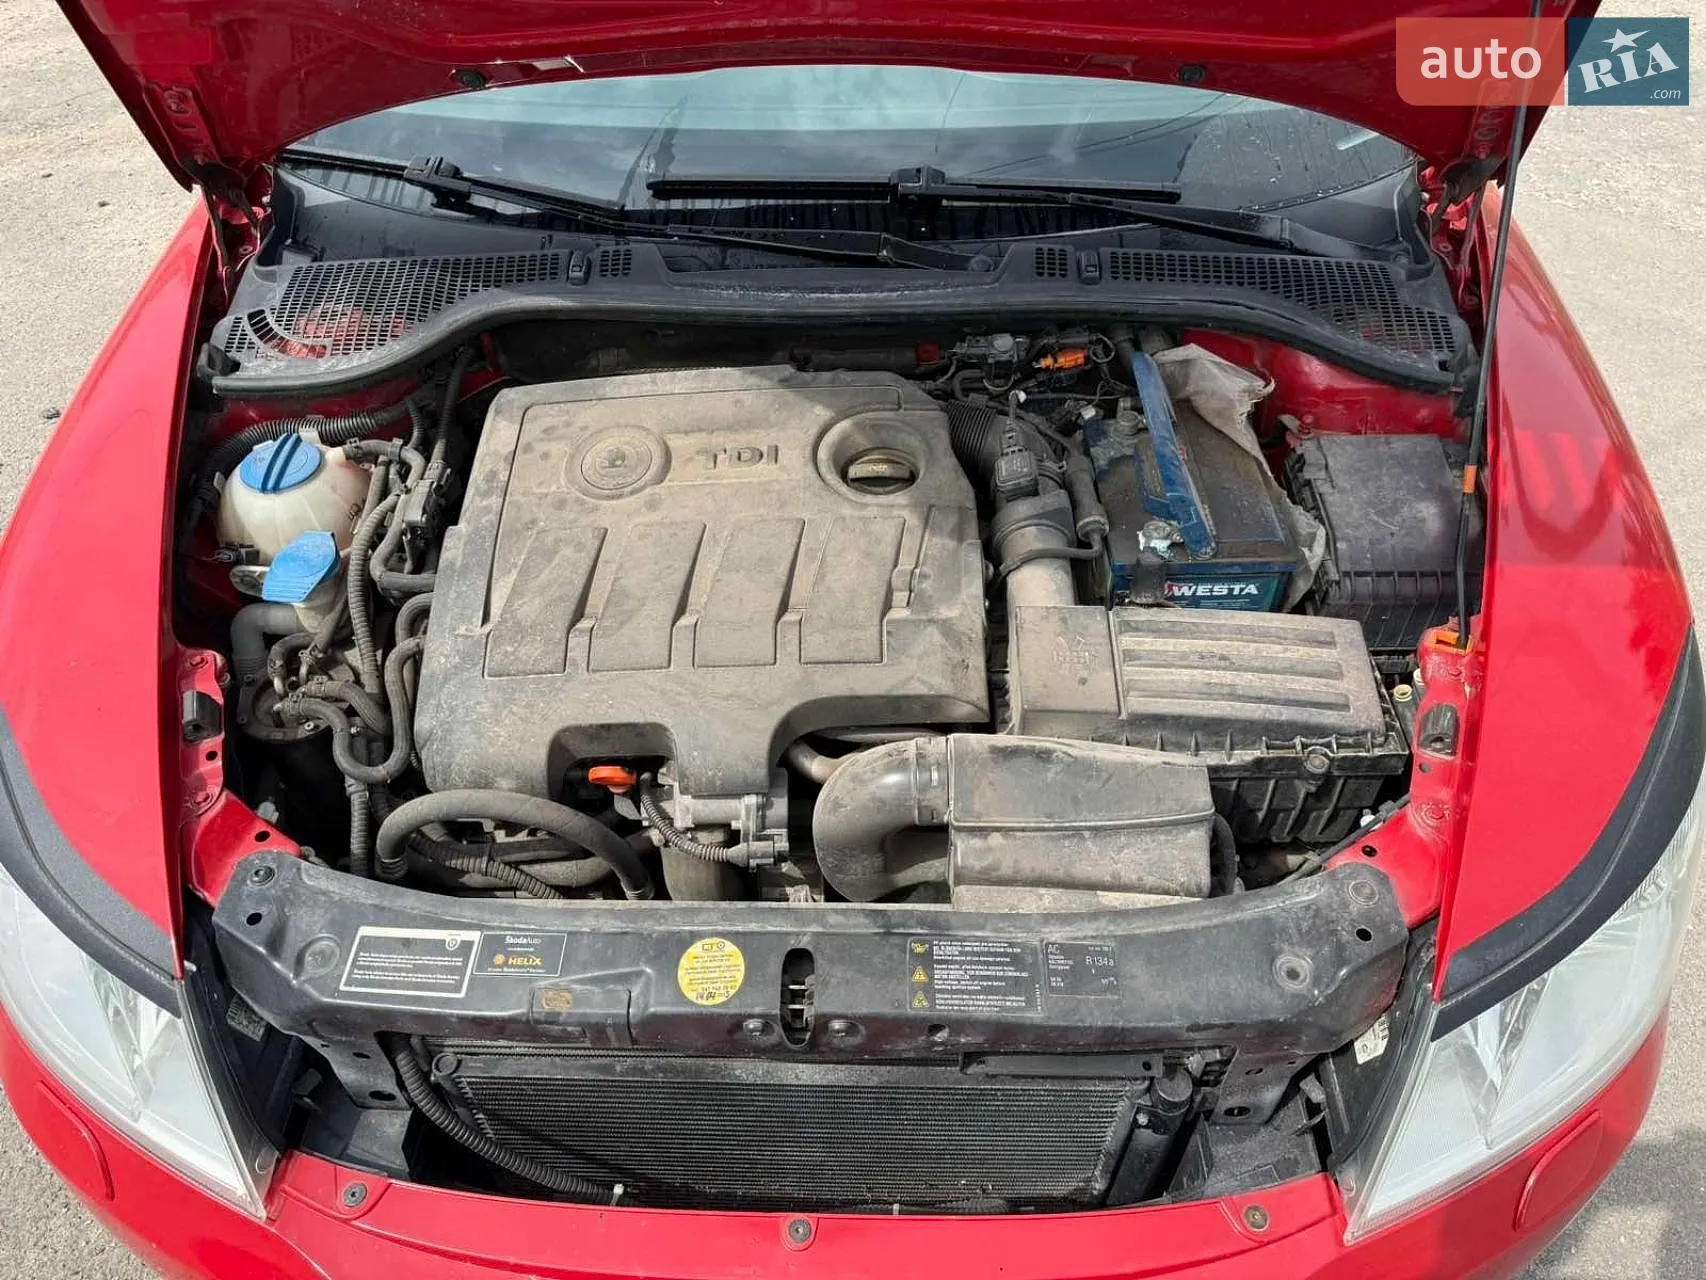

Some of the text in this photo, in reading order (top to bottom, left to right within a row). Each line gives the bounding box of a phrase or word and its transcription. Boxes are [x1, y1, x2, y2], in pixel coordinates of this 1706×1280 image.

[696, 444, 779, 471] TDI
[1172, 583, 1259, 597] WESTA
[508, 954, 542, 966] HELIX
